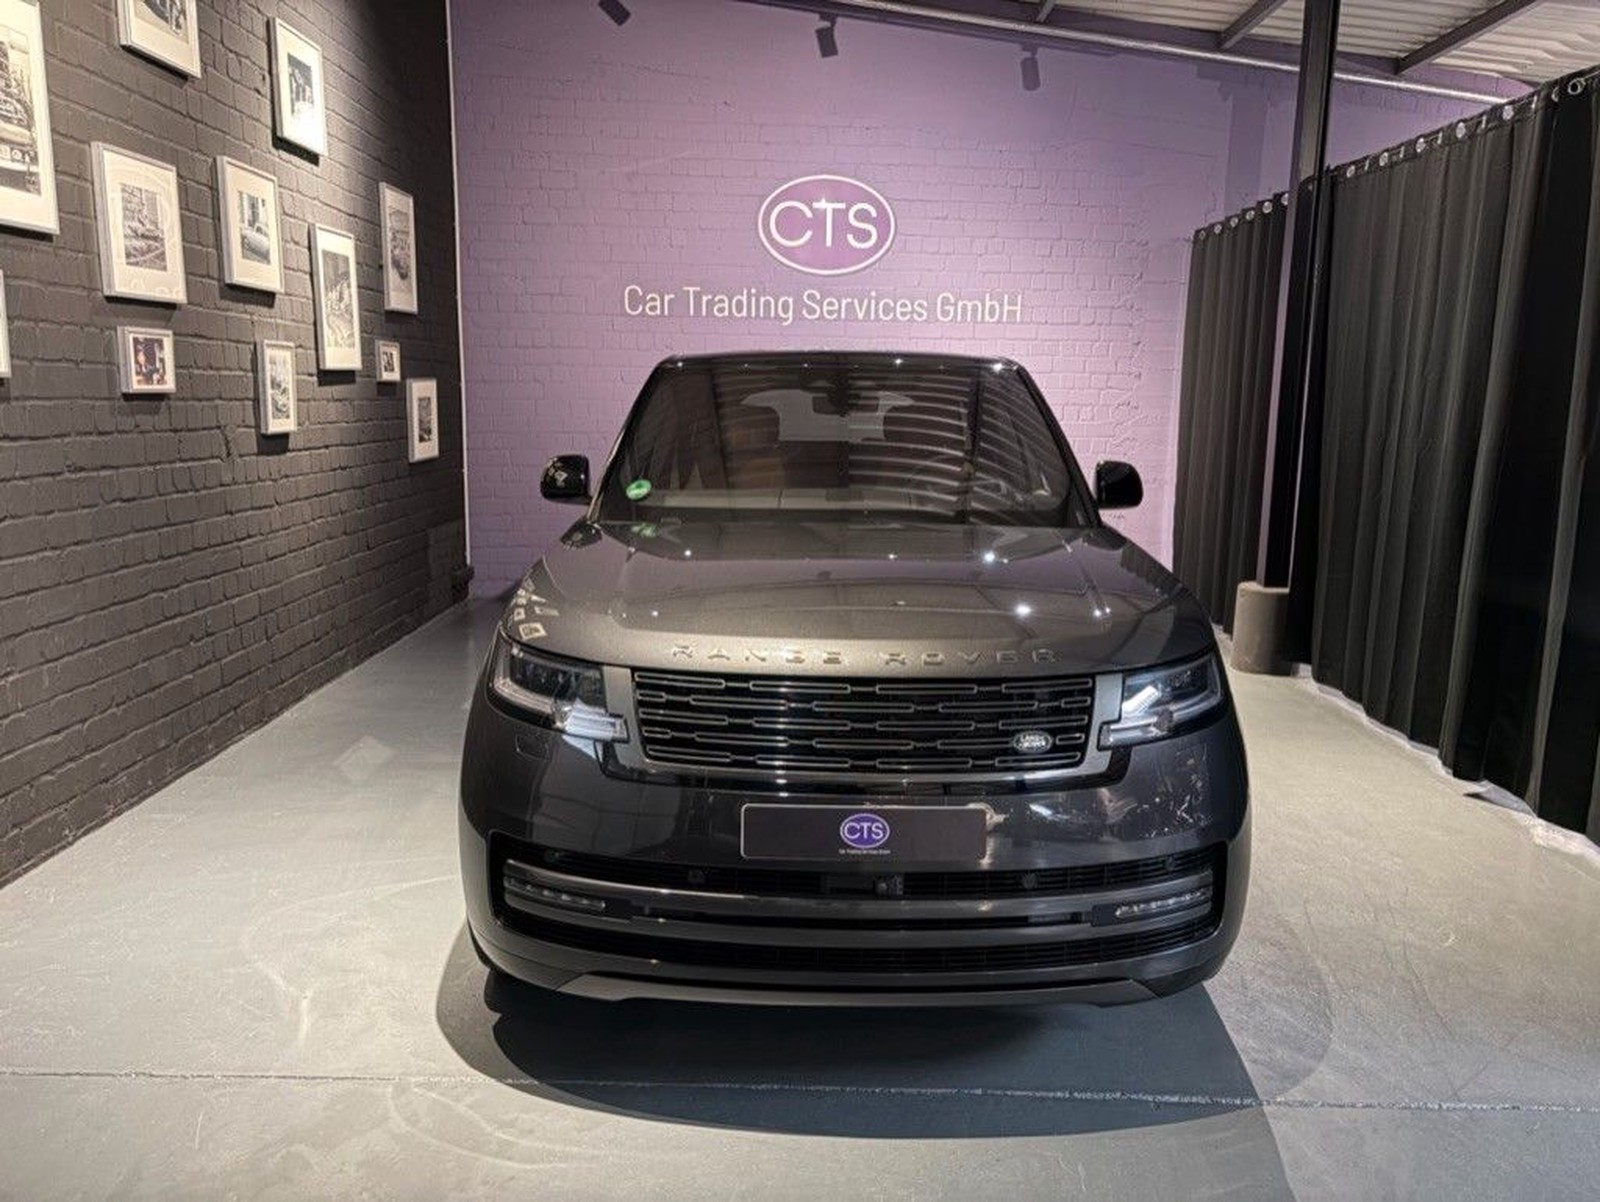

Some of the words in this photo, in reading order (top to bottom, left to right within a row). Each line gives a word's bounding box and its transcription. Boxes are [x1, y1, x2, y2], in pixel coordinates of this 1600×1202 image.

[769, 197, 879, 250] CTS
[624, 285, 675, 316] Car
[683, 286, 793, 326] Trading
[802, 289, 928, 322] Services
[936, 293, 1022, 323] GmbH
[844, 822, 884, 839] CTS
